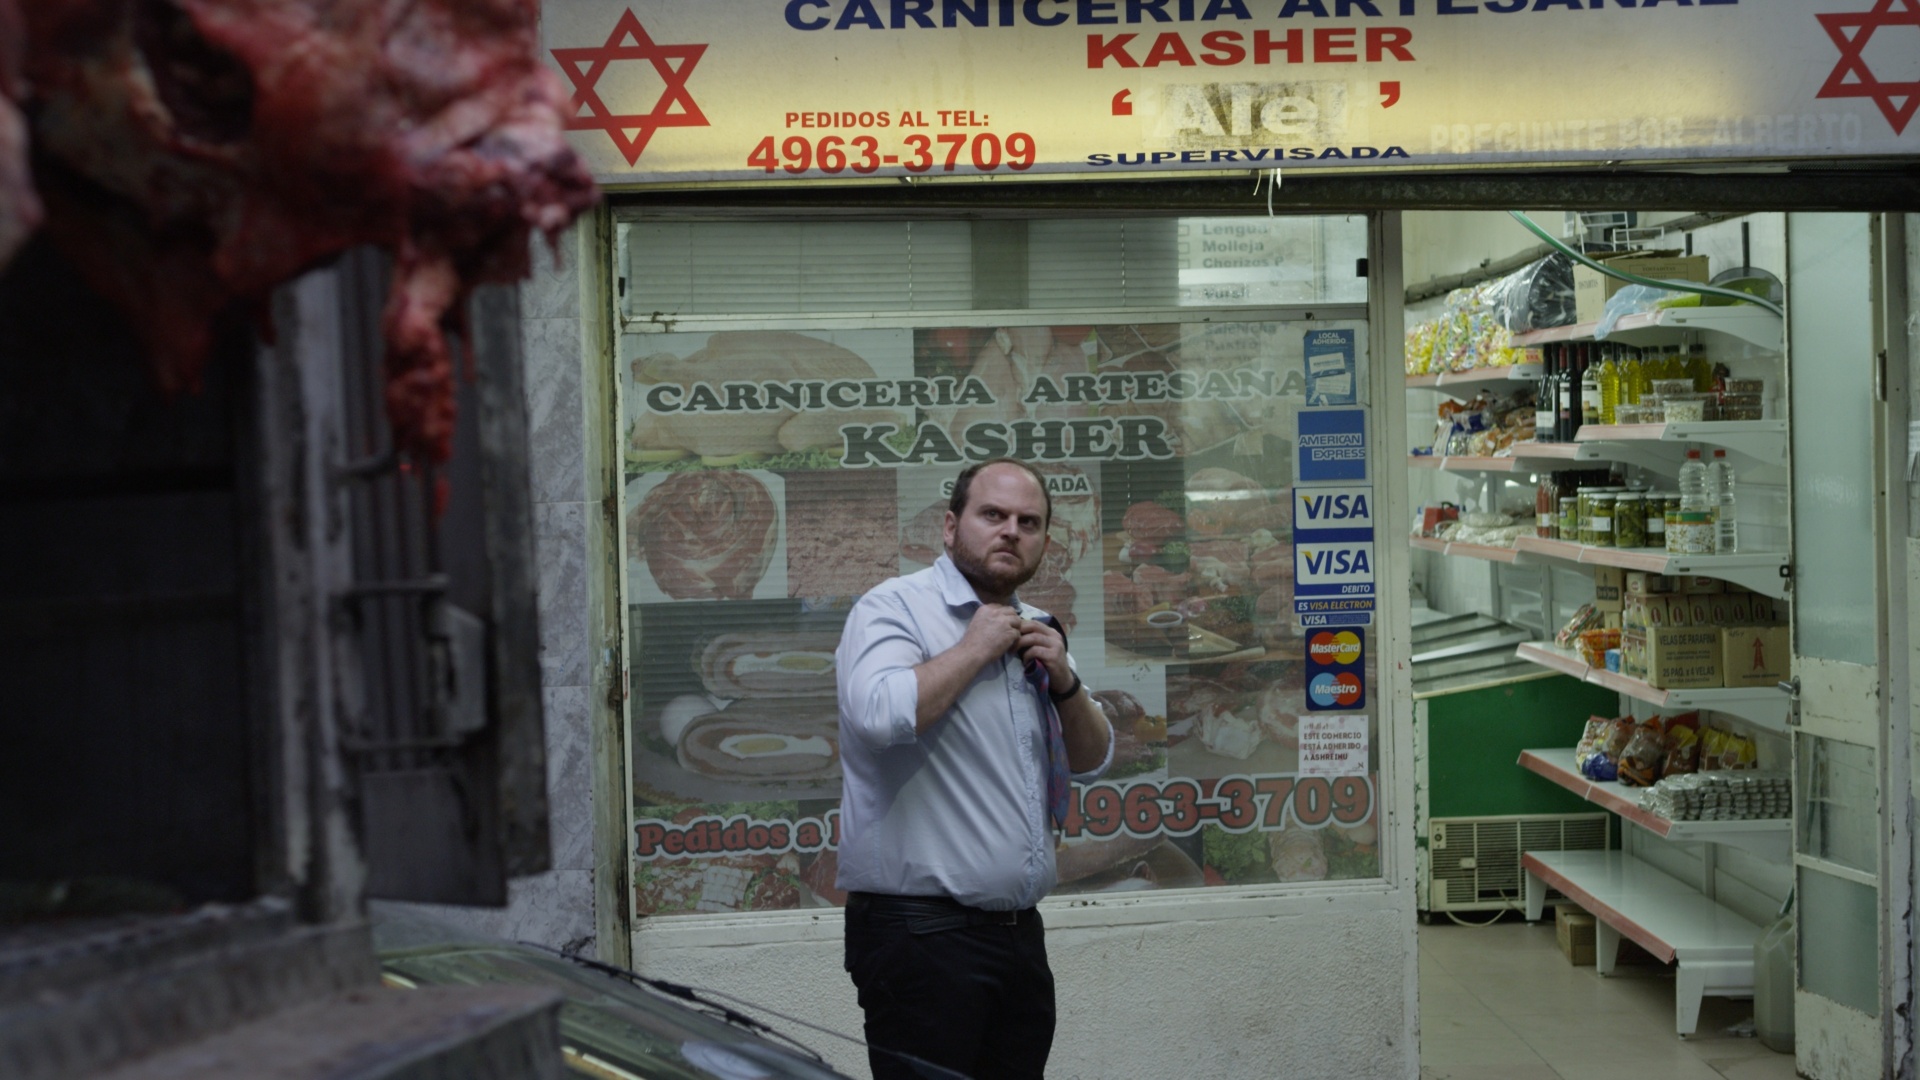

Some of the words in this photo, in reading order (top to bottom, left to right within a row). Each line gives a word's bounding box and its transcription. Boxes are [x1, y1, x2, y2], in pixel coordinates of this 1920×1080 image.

[784, 0, 1254, 31] CARNICERIA
[1086, 26, 1416, 69] KASHER
[785, 111, 891, 129] PEDIDOS
[898, 110, 930, 128] AL
[937, 110, 990, 127] TEL:
[1430, 117, 1606, 155] PREGUNTE
[1618, 115, 1684, 150] POR
[1717, 112, 1863, 146] ALBERTO
[748, 131, 1036, 174] 4963-3709
[1087, 146, 1411, 167] SUPERVISADA
[1202, 240, 1265, 254] Molleja
[646, 377, 996, 412] CARNICERIA
[841, 417, 1175, 467] KASHER
[1300, 434, 1361, 446] AMERICAN
[1312, 448, 1365, 460] EXPRESS
[1299, 494, 1369, 520] VISA
[1301, 549, 1370, 575] VISA
[1310, 602, 1329, 610] VISA
[1330, 600, 1373, 610] ELECTRON
[1303, 615, 1327, 625] VISA
[1311, 642, 1361, 653] MasterCard
[1659, 634, 1678, 646] VELAS
[1679, 634, 1688, 646] DE
[1315, 684, 1357, 695] Maestro
[1304, 732, 1320, 740] ESTE
[1321, 732, 1362, 740] COMERCIO
[1323, 742, 1361, 750] ADHERIDO
[1304, 753, 1309, 761] A
[635, 819, 790, 857] Pedidos
